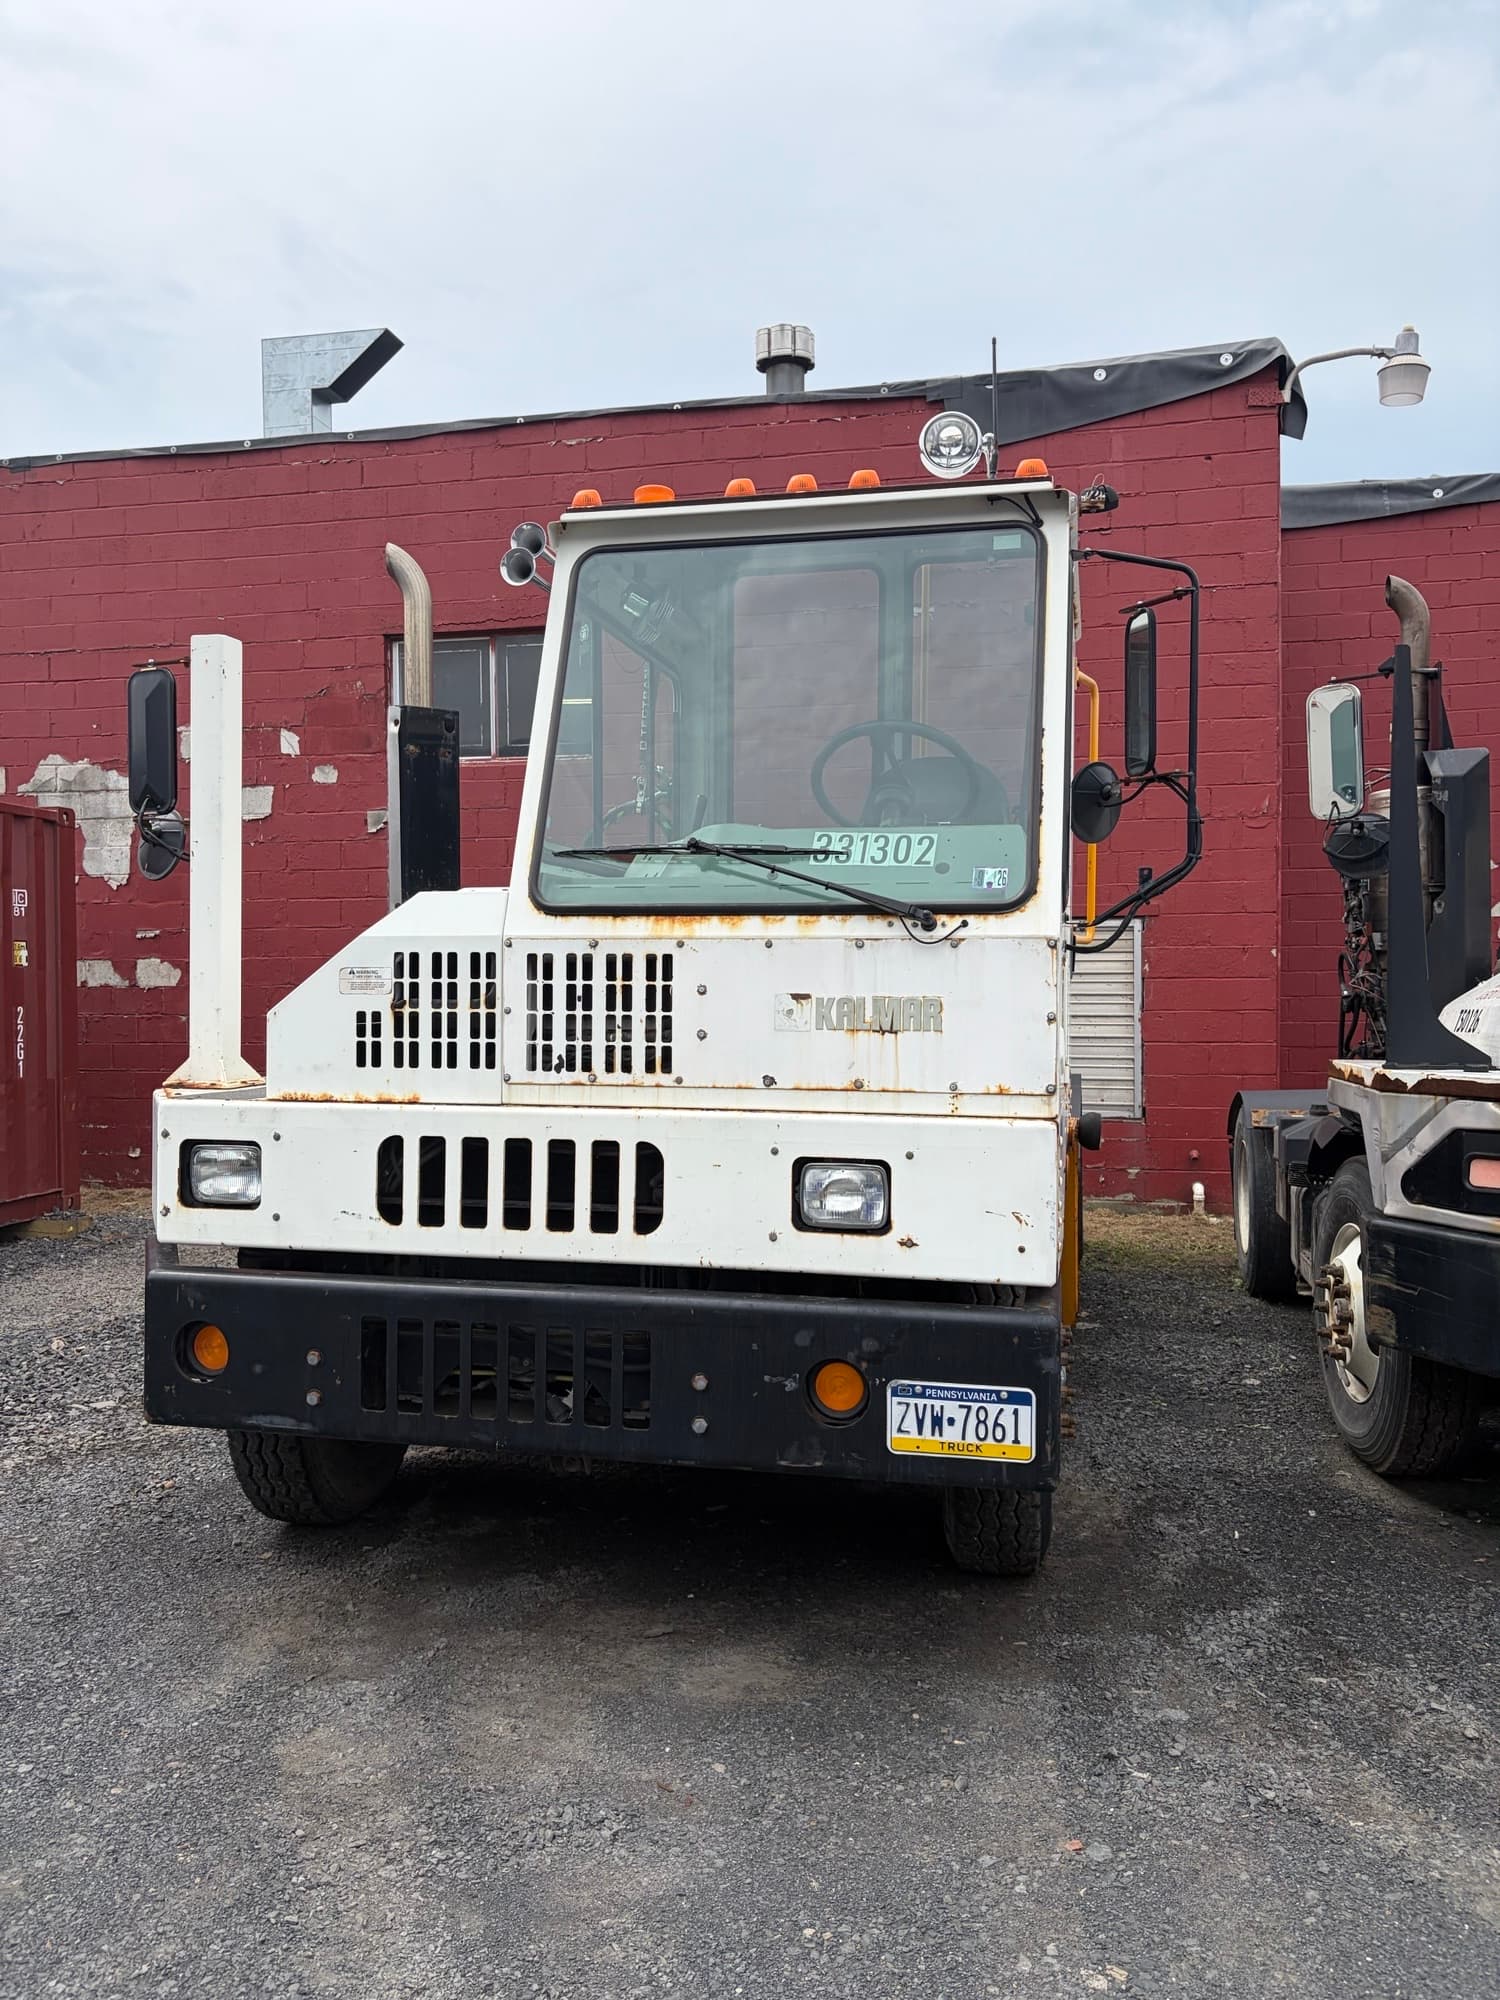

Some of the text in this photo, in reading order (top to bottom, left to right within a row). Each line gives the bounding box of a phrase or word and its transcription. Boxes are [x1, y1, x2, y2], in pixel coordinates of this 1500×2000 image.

[812, 833, 935, 865] 331302
[998, 869, 1007, 886] 26
[13, 906, 25, 917] 81
[815, 996, 944, 1034] KALMAR
[925, 1388, 998, 1401] PENNSYLVANIA
[939, 1441, 984, 1453] TRUCK
